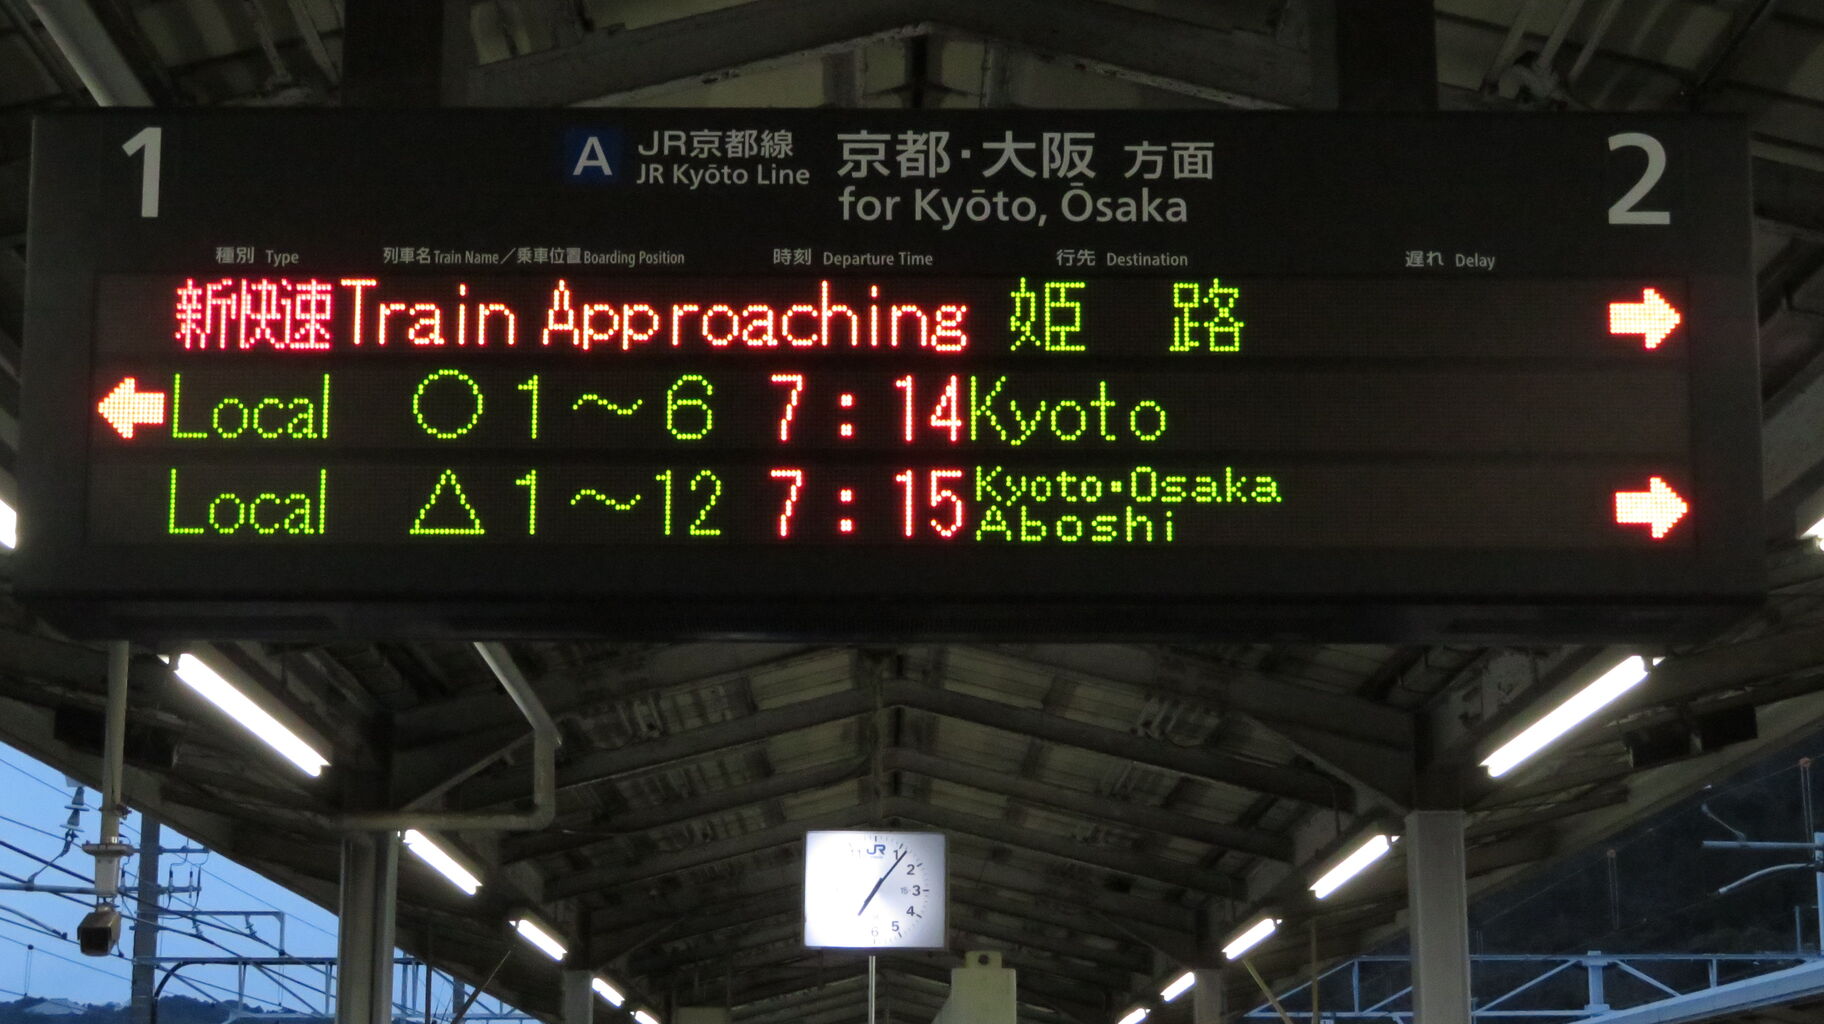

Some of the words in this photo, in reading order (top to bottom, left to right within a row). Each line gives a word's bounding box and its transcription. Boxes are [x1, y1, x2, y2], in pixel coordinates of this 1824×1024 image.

[573, 137, 612, 175] A
[638, 130, 793, 159] JR京都線
[122, 127, 163, 218] 1
[1124, 141, 1215, 179] 方面
[636, 164, 664, 184] JR
[673, 164, 749, 189] Kyōto
[757, 163, 810, 185] Line
[1608, 133, 1671, 225] 2
[839, 186, 901, 221] for
[914, 188, 1047, 230] Kyōto,
[1061, 182, 1187, 223] Ōsaka
[215, 247, 255, 265] 種別
[265, 249, 299, 267] Type
[383, 247, 431, 264] 列車名
[433, 250, 462, 264] Train
[583, 250, 636, 267] Boarding
[639, 250, 685, 264] Position
[773, 249, 812, 266] 時刻
[823, 251, 895, 268] Departure
[898, 251, 933, 266] Time
[1056, 249, 1096, 266] 行先
[1106, 252, 1188, 266] Destination
[1405, 250, 1444, 267] 遅れ
[1455, 252, 1495, 270] Delay
[175, 278, 334, 351] 新快速
[340, 278, 518, 346] Train
[542, 279, 969, 352] Approaching
[171, 373, 330, 440] Local
[969, 375, 1167, 446] Kyoto
[168, 469, 327, 535] Local
[975, 505, 1174, 542] Aboshi
[866, 843, 887, 855] JR
[906, 863, 916, 876] 2
[912, 884, 921, 897] 3
[905, 905, 916, 917] 4
[891, 920, 900, 932] 5
